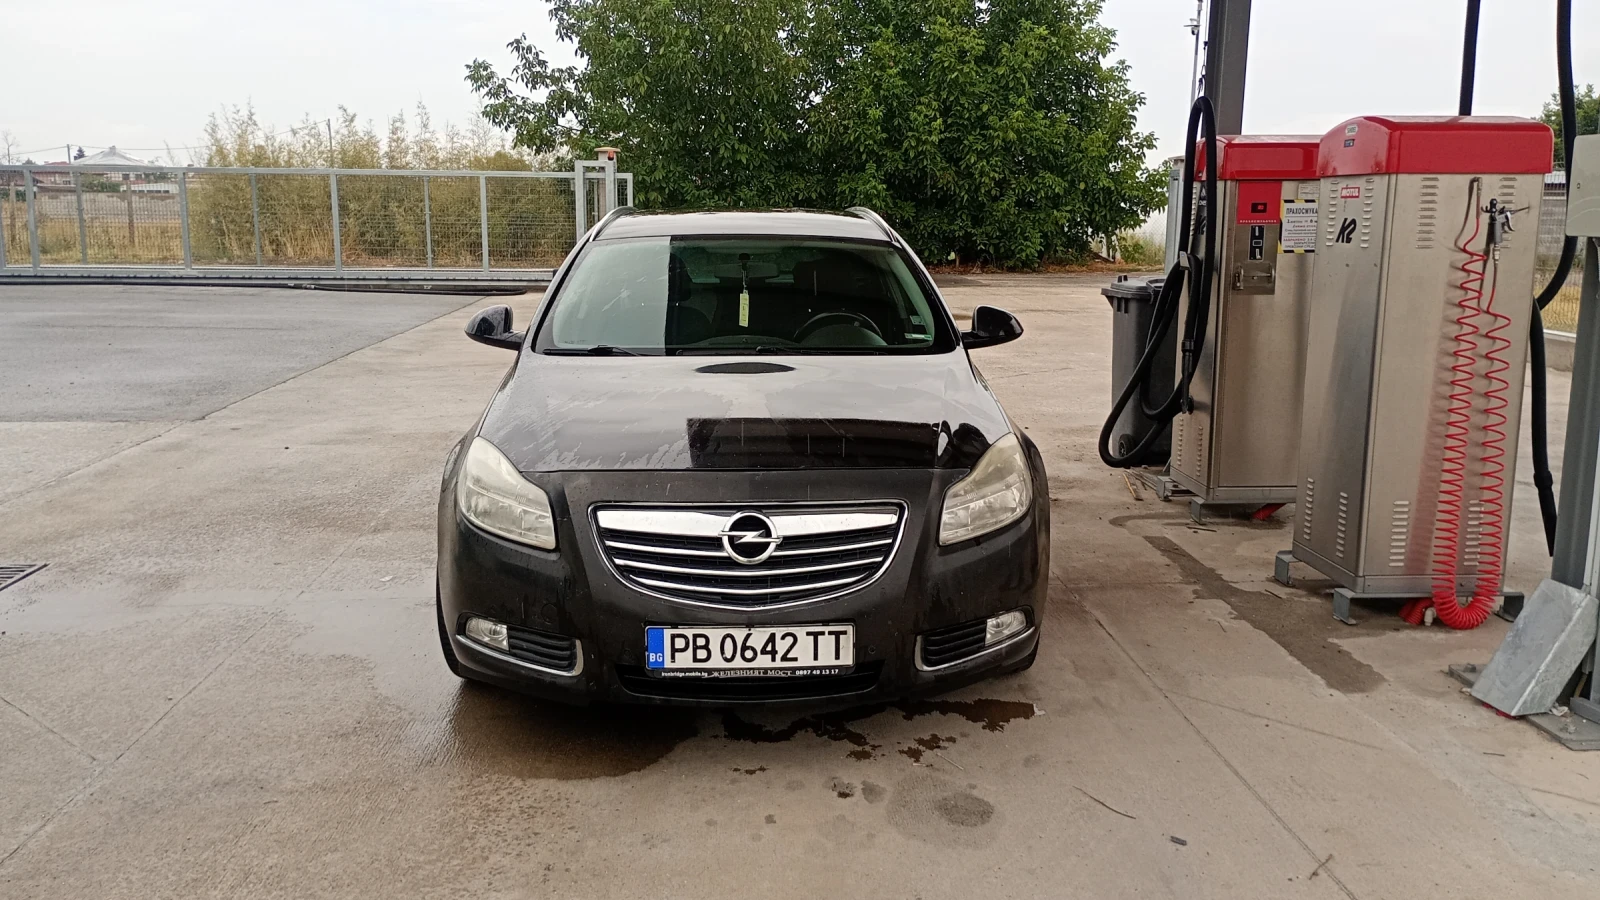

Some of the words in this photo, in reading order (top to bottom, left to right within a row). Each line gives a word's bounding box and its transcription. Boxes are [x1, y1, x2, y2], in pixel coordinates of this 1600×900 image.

[1335, 217, 1357, 244] K2
[649, 652, 663, 662] BG
[670, 632, 712, 664] PB
[719, 631, 799, 663] 0642
[805, 630, 848, 661] TT
